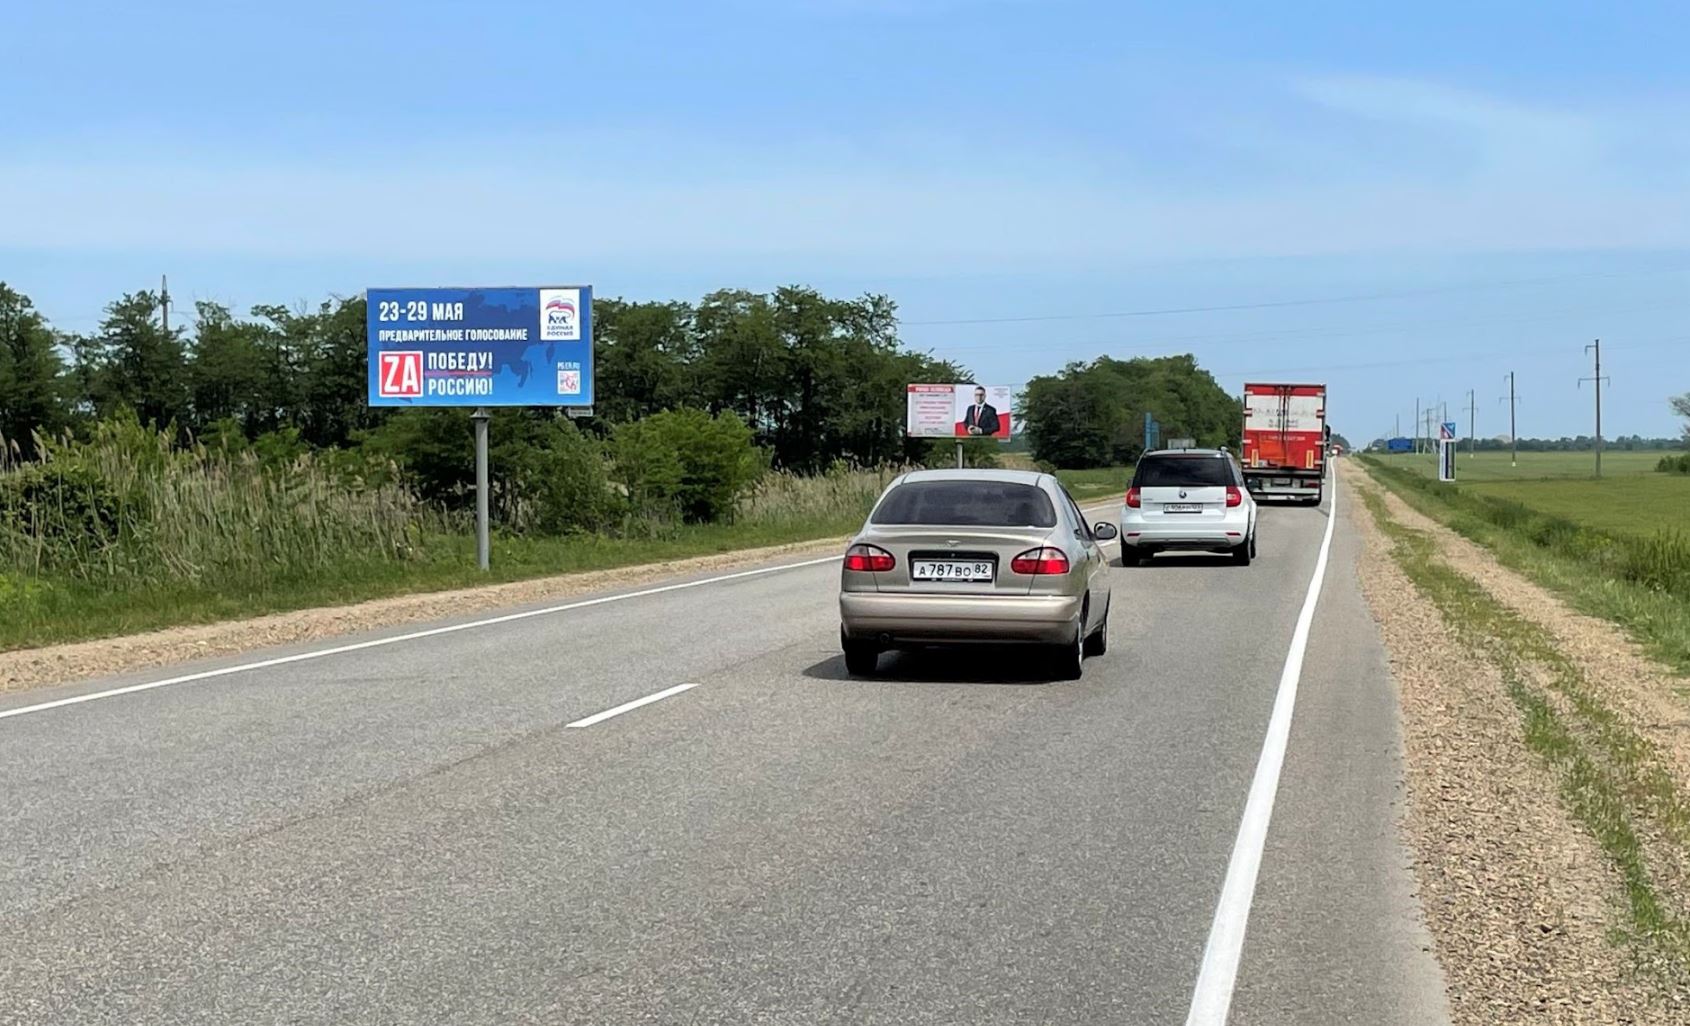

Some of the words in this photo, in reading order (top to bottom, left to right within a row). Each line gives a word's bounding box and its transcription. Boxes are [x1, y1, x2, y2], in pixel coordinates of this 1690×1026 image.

[379, 301, 428, 322] 23-29
[432, 302, 464, 321] МАЯ
[379, 329, 464, 342] ПРЕДВАРИТЕЛЬНОЕ
[465, 328, 528, 341] ГОЛОСОВАНИЕ
[428, 351, 493, 371] ПОБЕДУ!
[383, 355, 420, 393] ZA
[428, 378, 493, 396] РОССИЮ!
[974, 563, 988, 574] 82
